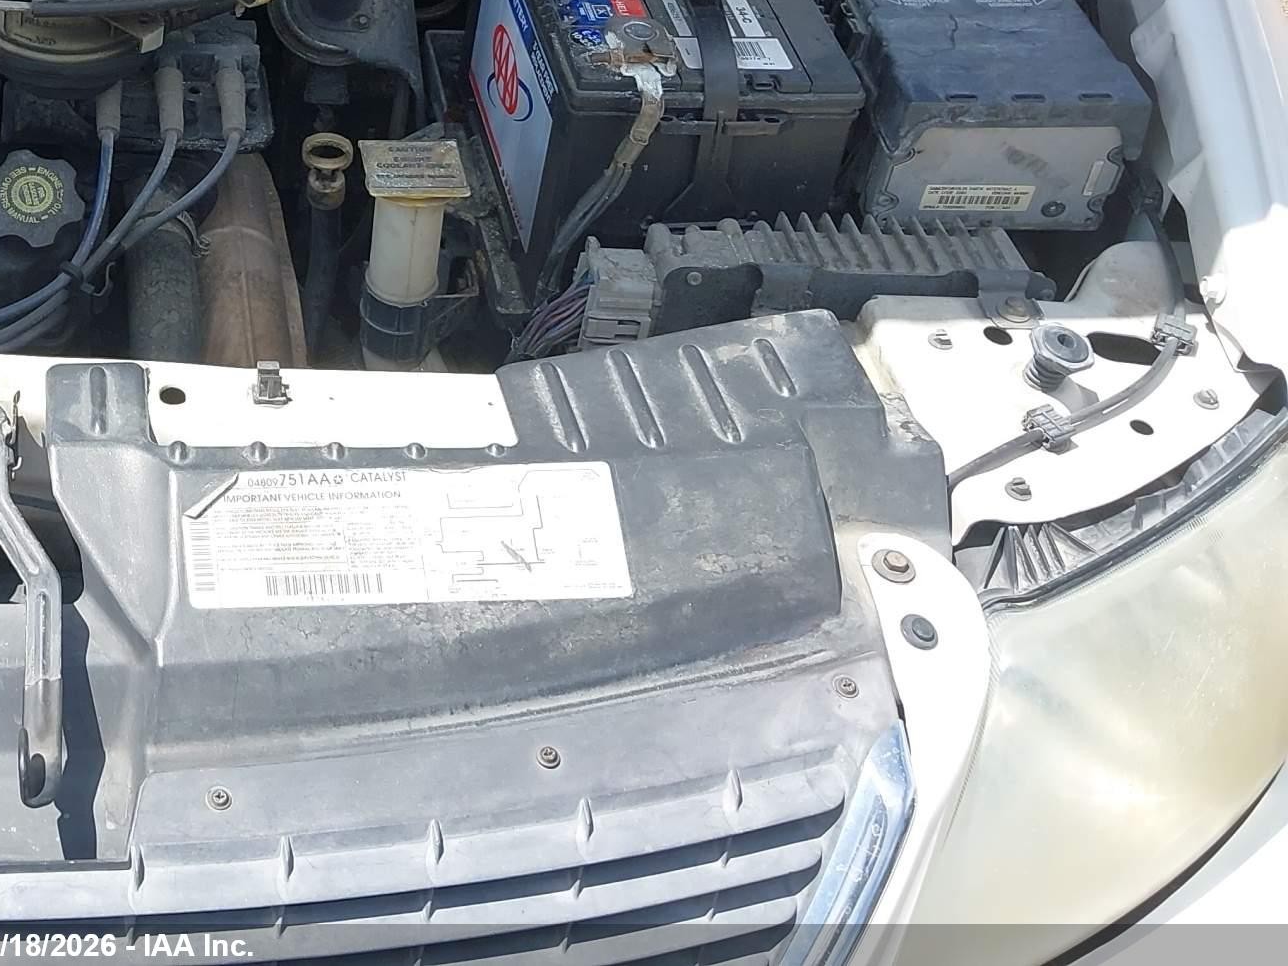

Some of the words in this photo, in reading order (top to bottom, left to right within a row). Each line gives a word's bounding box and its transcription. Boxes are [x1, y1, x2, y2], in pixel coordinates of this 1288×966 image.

[9, 166, 27, 178] SEE
[37, 166, 64, 190] ENGINE
[7, 207, 40, 224] MANUAL
[48, 204, 62, 216] OIL
[350, 471, 408, 483] CATALYST
[222, 492, 283, 504] IMPORTANT
[284, 491, 325, 503] VEHICLE
[328, 489, 402, 501] INFORMATION
